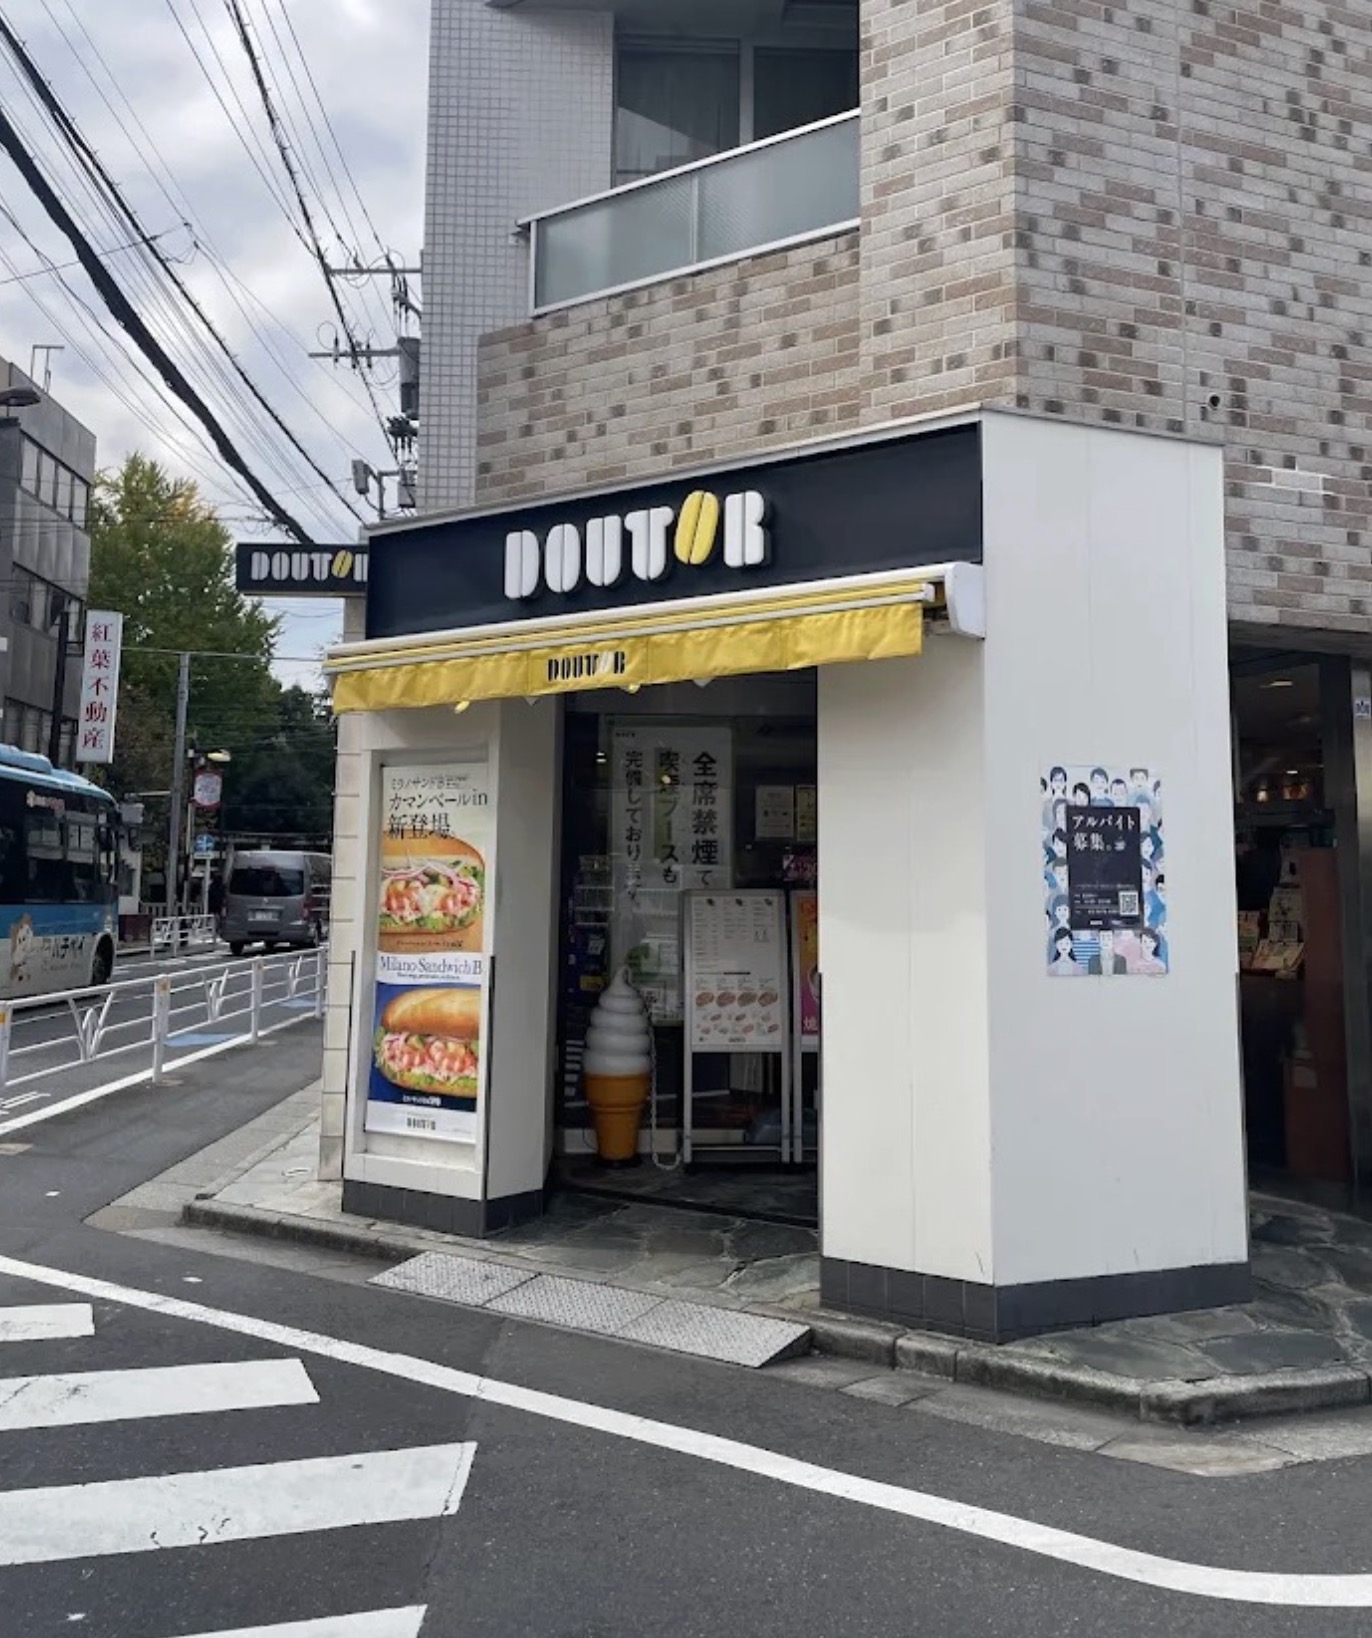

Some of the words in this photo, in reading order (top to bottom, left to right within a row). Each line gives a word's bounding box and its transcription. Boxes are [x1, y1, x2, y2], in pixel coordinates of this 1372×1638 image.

[504, 490, 765, 600] DOUTOR
[548, 651, 625, 682] DOUTOR
[82, 623, 113, 749] 紅葉不動産
[1072, 814, 1136, 832] アルバイト
[380, 955, 417, 973] Milano
[418, 957, 472, 975] Sandwich
